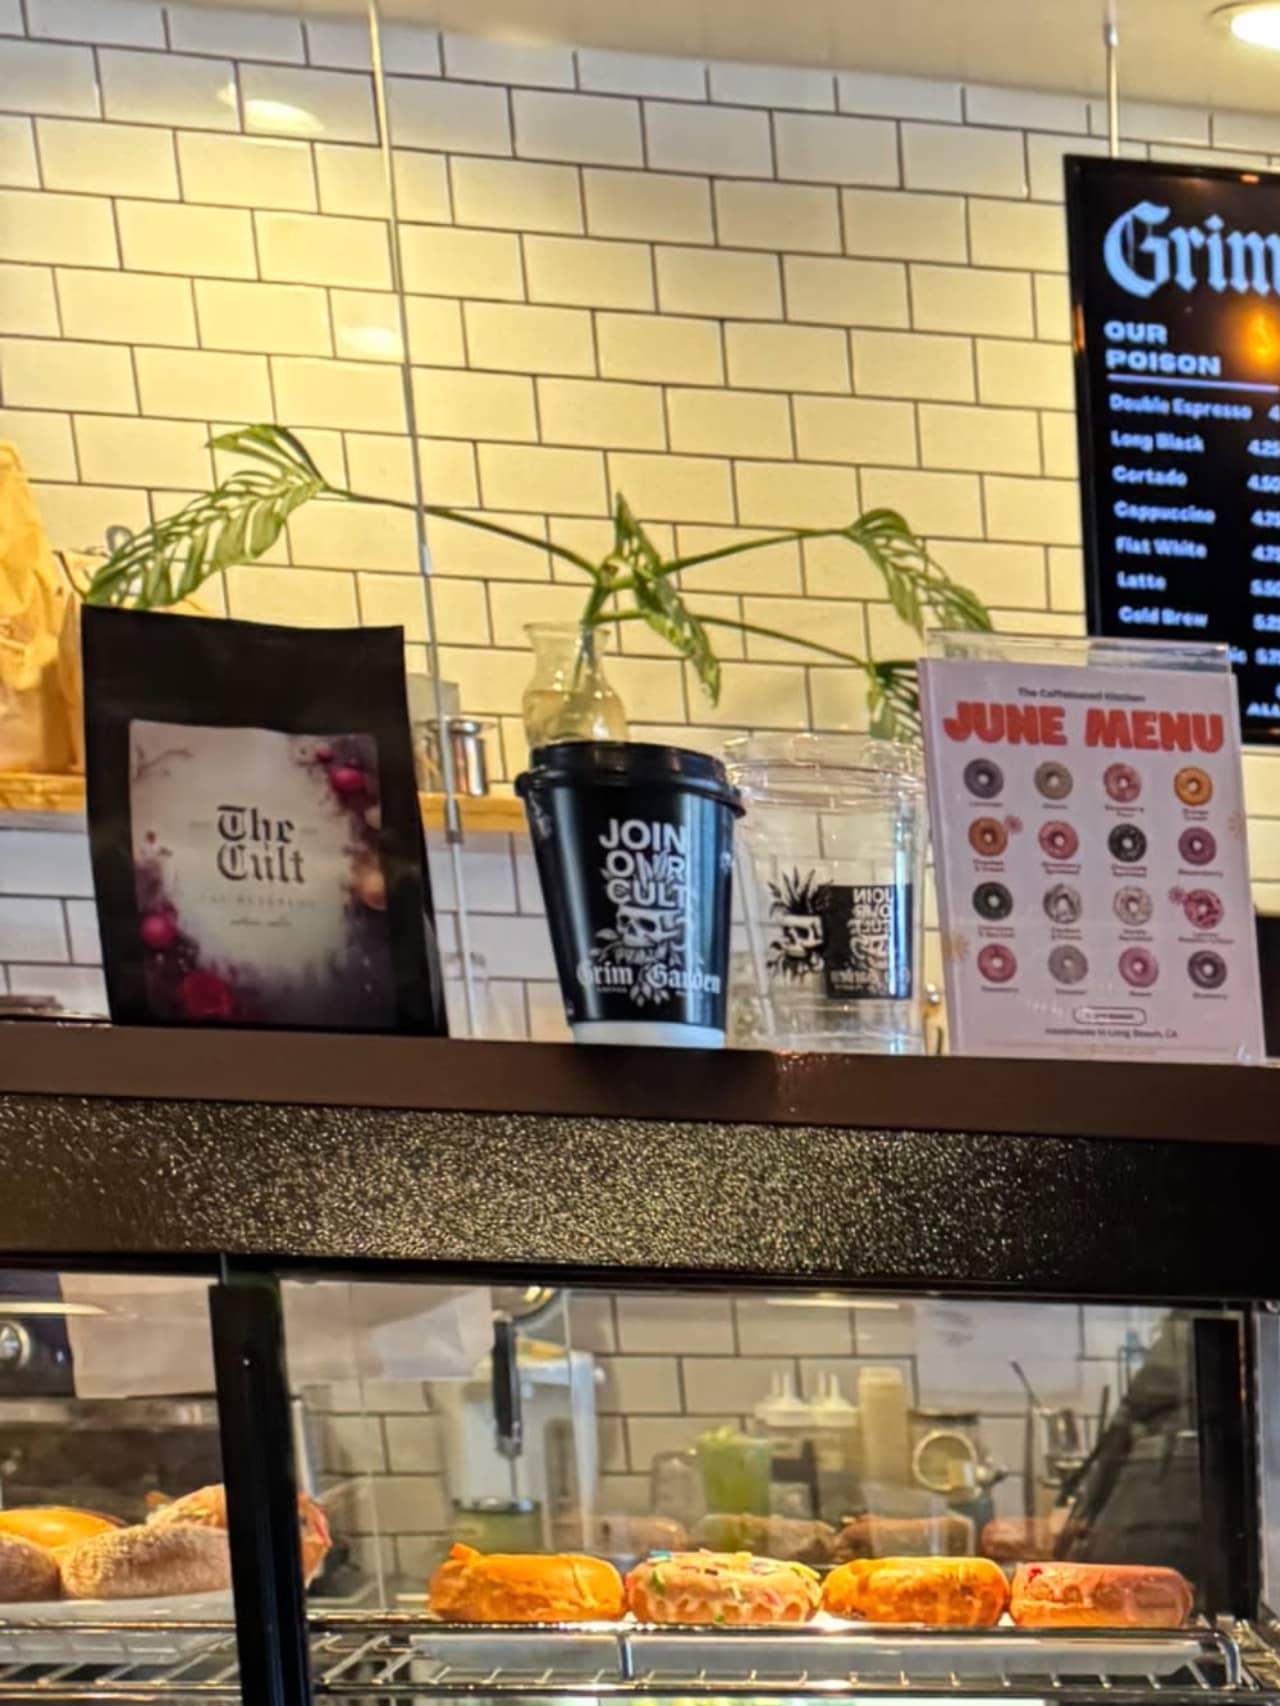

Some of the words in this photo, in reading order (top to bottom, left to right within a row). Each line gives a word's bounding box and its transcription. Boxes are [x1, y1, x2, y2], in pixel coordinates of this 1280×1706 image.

[1104, 320, 1167, 345] OUR
[1105, 349, 1221, 376] POISON
[1172, 398, 1252, 420] Espresso
[1111, 430, 1153, 453] Long
[1155, 431, 1204, 452] Black
[1112, 465, 1188, 488] Cortado
[1113, 500, 1216, 524] Cappuccino
[1115, 535, 1151, 555] Flat
[1153, 538, 1207, 559] White
[1117, 571, 1167, 591] Latte
[1118, 605, 1160, 625] Cold
[1161, 607, 1208, 628] Brew
[943, 700, 1067, 747] JUNE
[1085, 708, 1224, 754] MENU
[217, 805, 294, 843] The
[599, 818, 686, 852] JOIN
[217, 843, 304, 883] Cult
[607, 878, 689, 907] CULT
[577, 960, 633, 987] Grim
[645, 962, 721, 993] Garden
